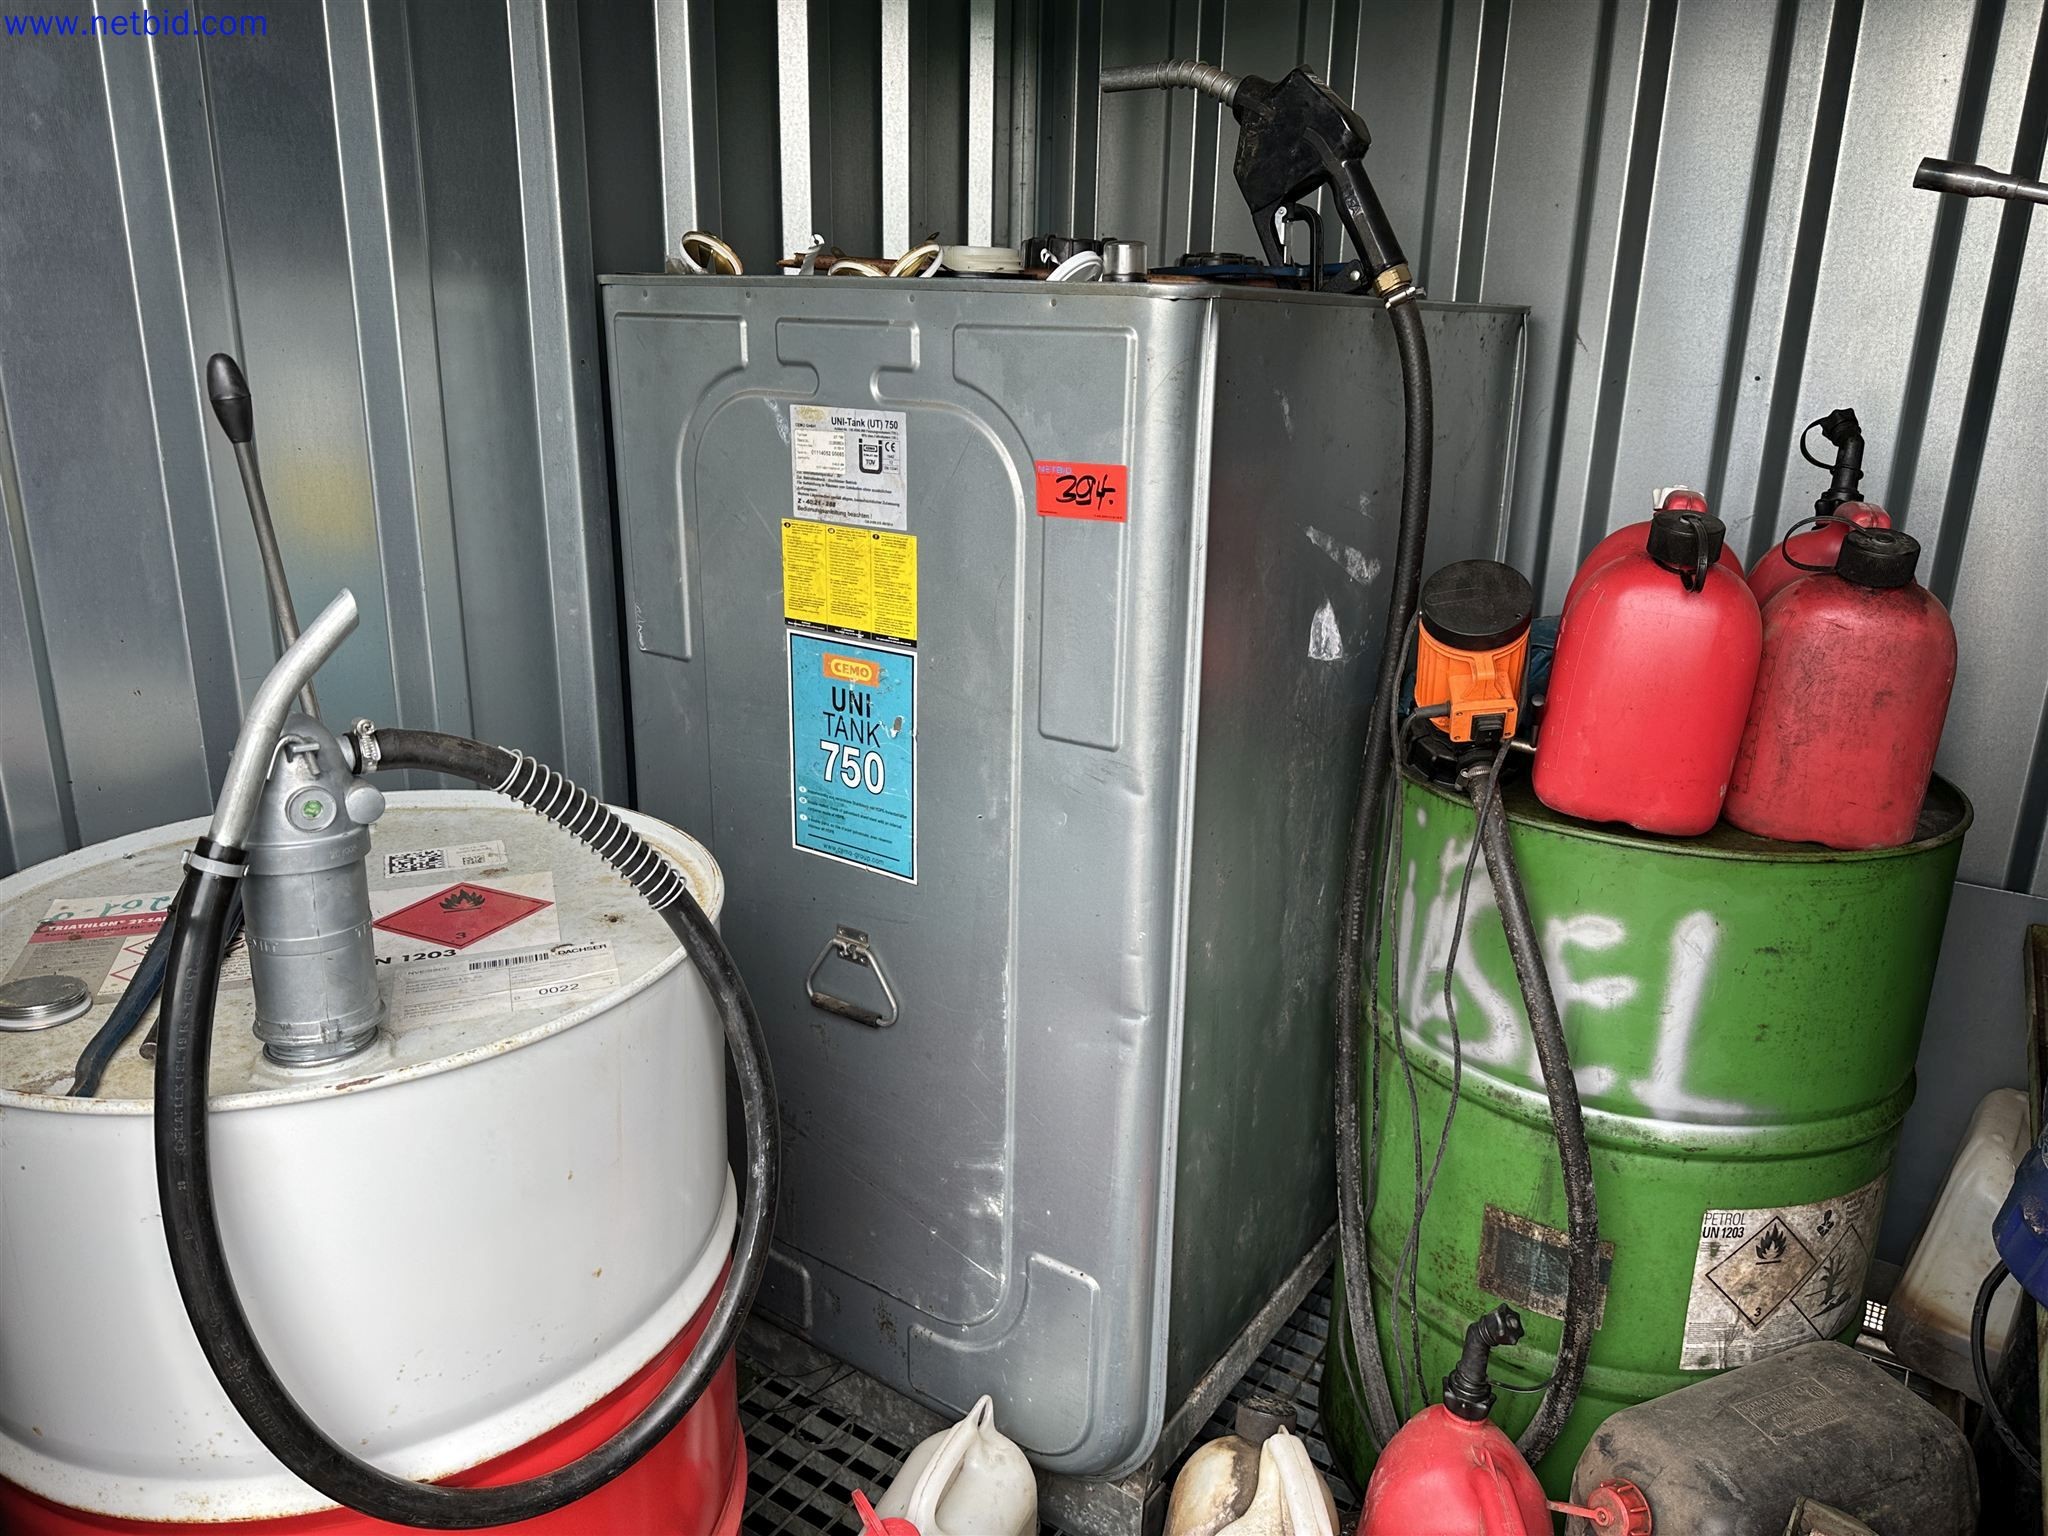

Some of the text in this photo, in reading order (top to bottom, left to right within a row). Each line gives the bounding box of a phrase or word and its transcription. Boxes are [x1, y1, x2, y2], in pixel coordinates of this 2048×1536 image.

[831, 416, 899, 430] UNI-Tank (UT) 750
[834, 661, 870, 679] CEMO
[831, 686, 871, 719] UNI
[822, 711, 881, 749] TANK
[819, 739, 886, 796] 750
[455, 931, 467, 940] 3
[402, 948, 458, 963] 1203
[557, 943, 608, 956] DACHSER
[538, 982, 580, 996] 0022
[1703, 1212, 1747, 1226] PETROL
[1702, 1226, 1745, 1239] UN 1203
[1753, 1306, 1762, 1318] 3
